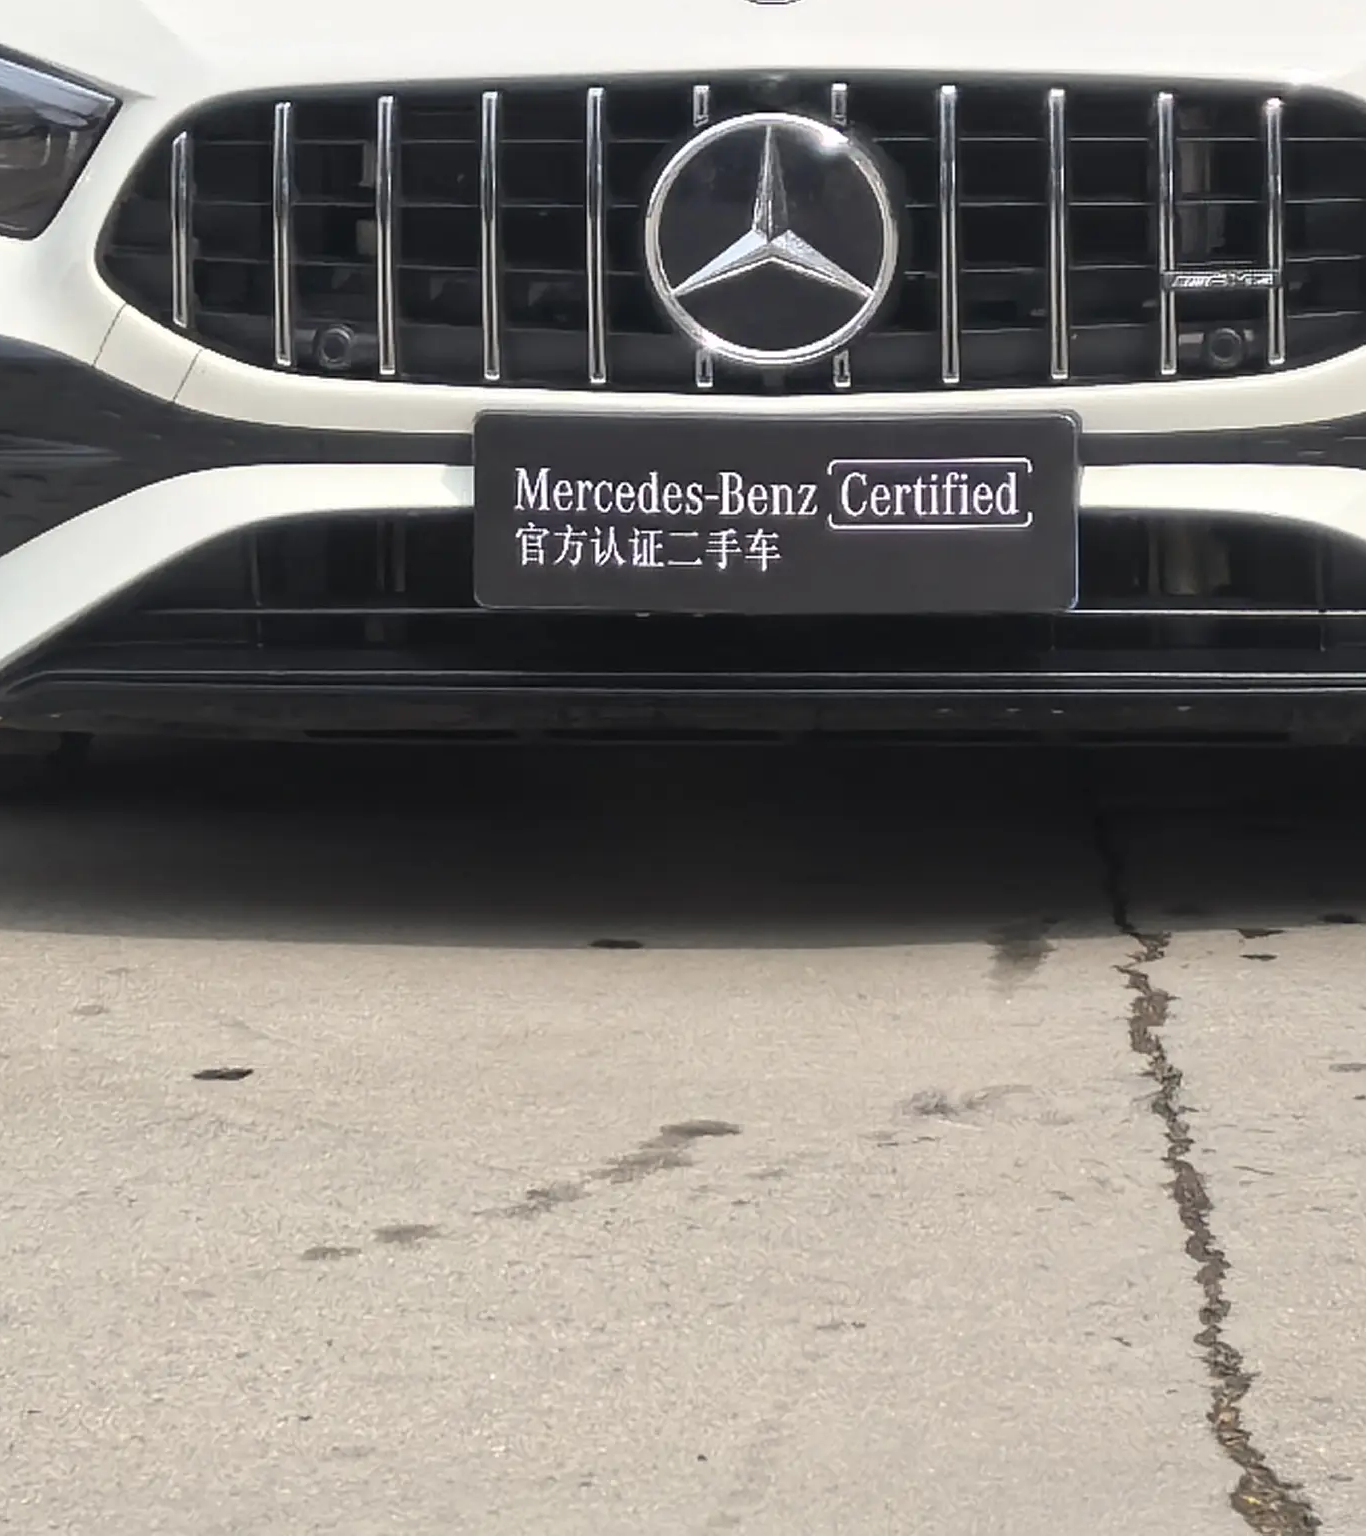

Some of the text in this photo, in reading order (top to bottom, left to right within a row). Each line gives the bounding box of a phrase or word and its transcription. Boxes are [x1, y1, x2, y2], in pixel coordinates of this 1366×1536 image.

[515, 467, 1020, 517] Mercedes-Benz Certified
[515, 523, 782, 572] 官方认证二手车
